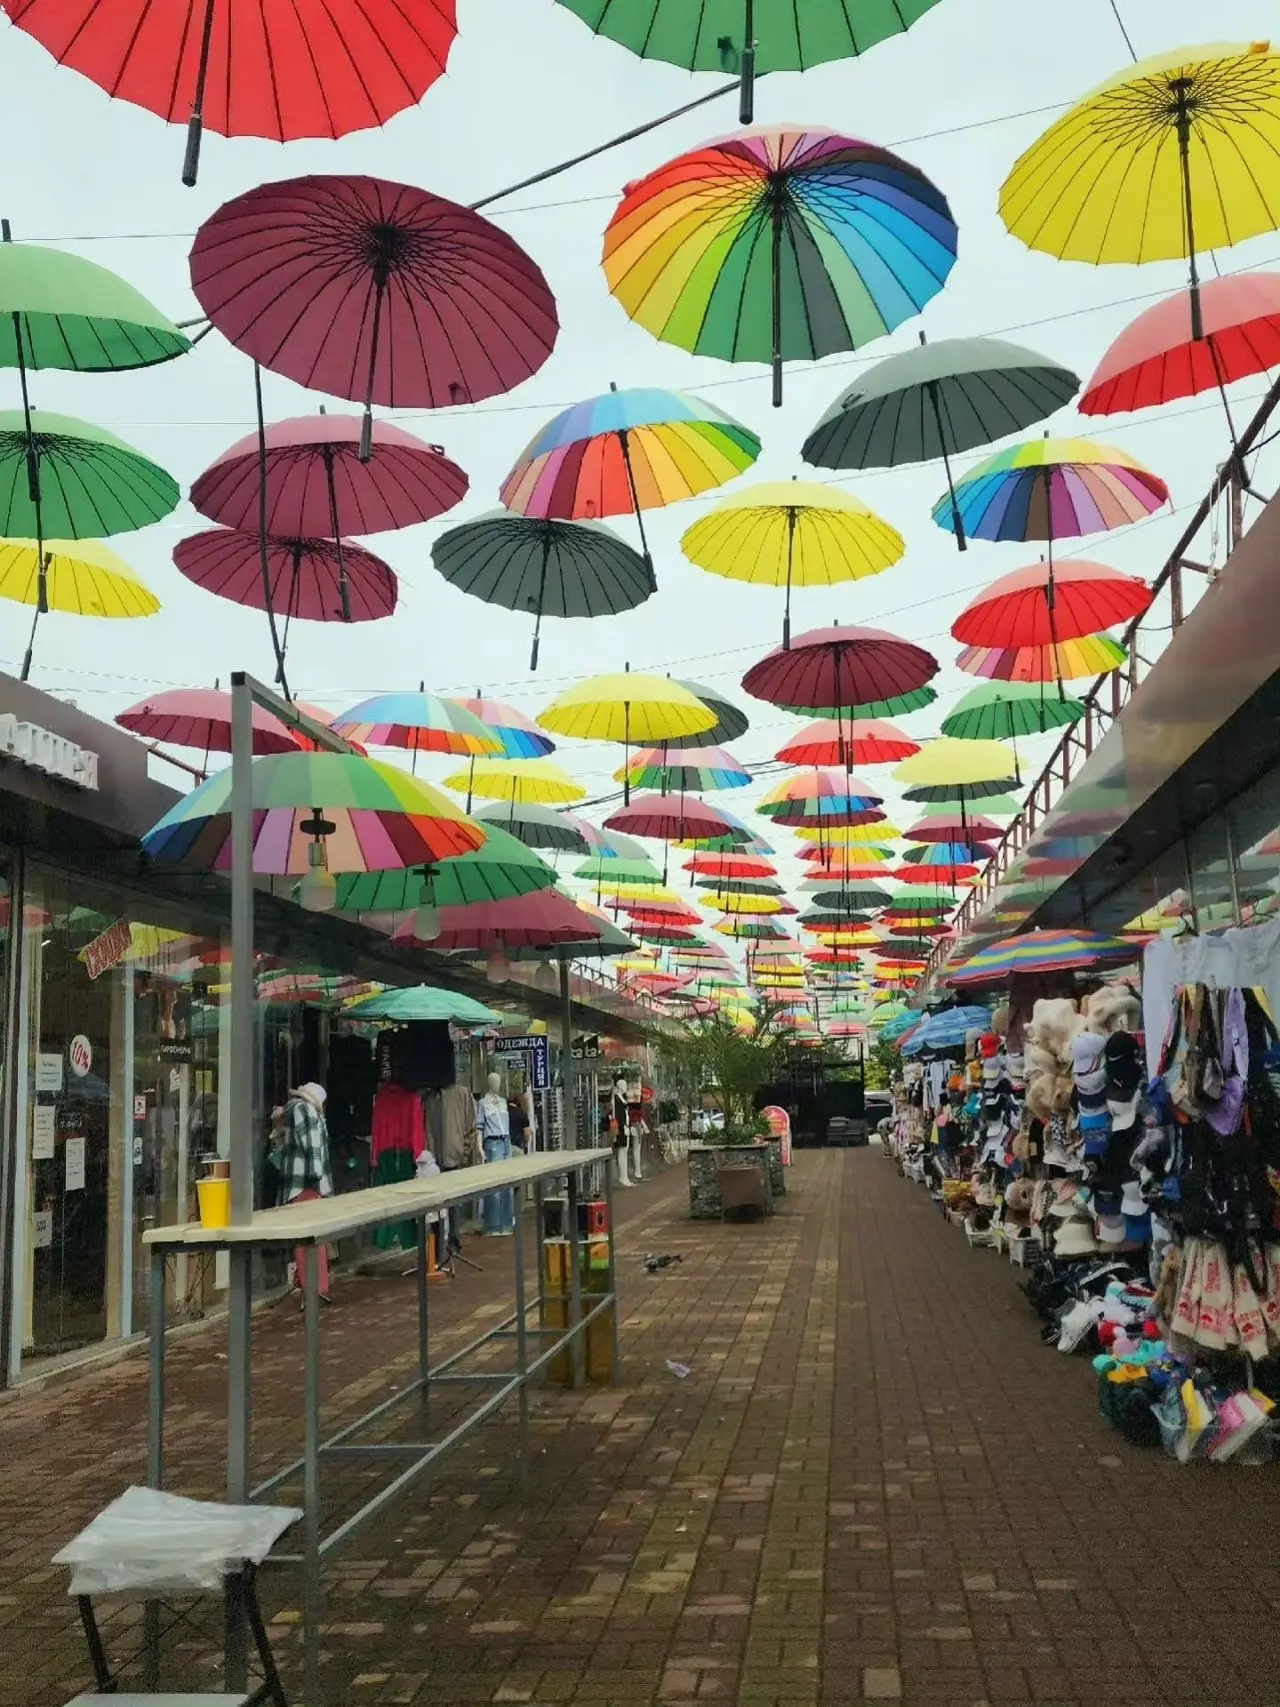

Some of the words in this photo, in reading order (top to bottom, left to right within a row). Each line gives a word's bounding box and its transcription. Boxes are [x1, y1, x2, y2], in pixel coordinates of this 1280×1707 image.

[72, 1041, 89, 1070] 10%
[497, 1037, 545, 1050] ОДЕЖДА
[536, 1049, 545, 1086] ТУРЦИЯ
